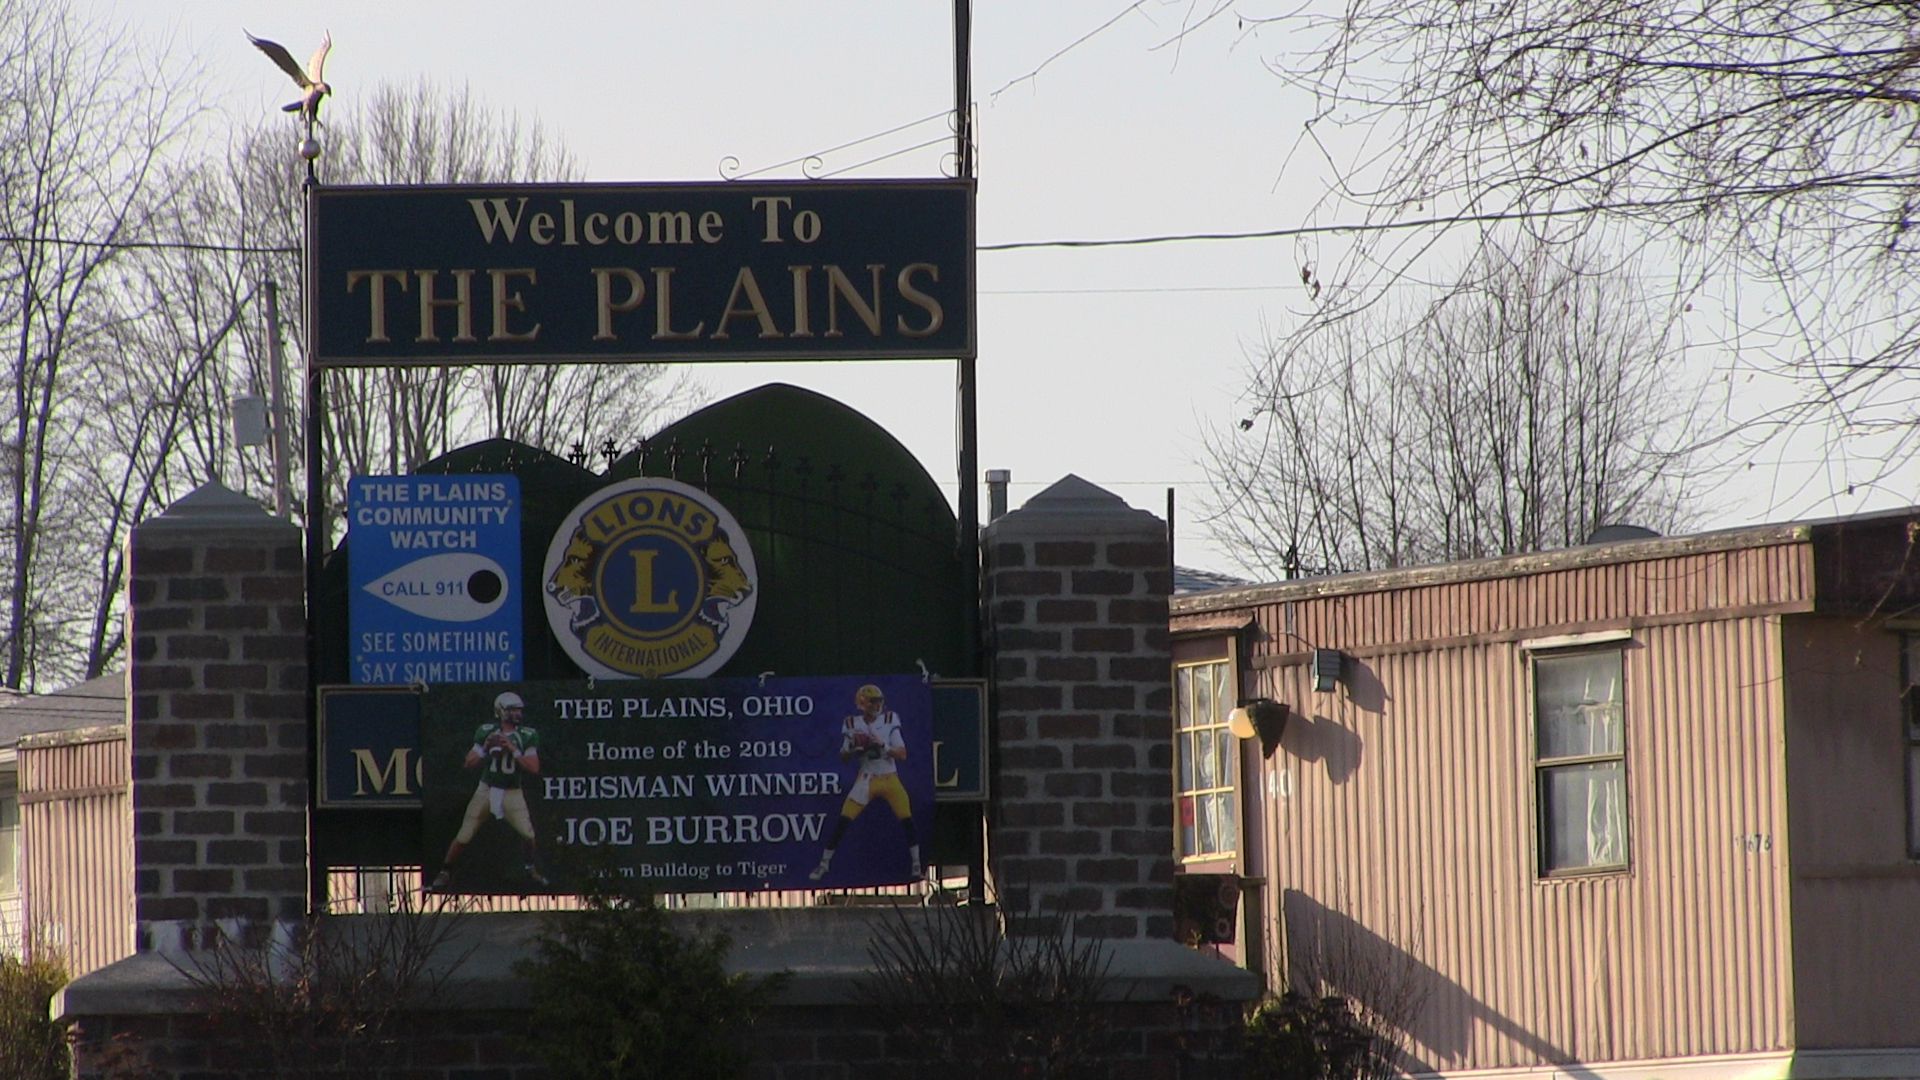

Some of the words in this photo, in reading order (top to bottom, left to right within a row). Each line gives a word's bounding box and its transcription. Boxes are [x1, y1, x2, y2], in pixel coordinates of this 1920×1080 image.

[469, 197, 724, 246] Welcome
[752, 196, 822, 244] To
[346, 268, 541, 343] THE
[591, 263, 943, 341] PLAINS
[360, 484, 409, 501] THE
[417, 483, 506, 501] PLAINS
[357, 507, 510, 526] COMMUNITY
[592, 496, 708, 536] LIONS
[390, 531, 477, 549] WATCH
[382, 582, 430, 596] CALL
[435, 581, 463, 595] 911
[629, 549, 679, 613] L
[362, 632, 396, 652] SEE
[402, 631, 510, 651] SOMETHING
[594, 633, 708, 667] INTERNATIONAL
[361, 663, 397, 682] SAY
[404, 661, 511, 682] SOMETHING
[554, 699, 613, 719] THE
[622, 697, 734, 719] PLAINS,
[742, 695, 814, 716] OHIO
[587, 742, 655, 760] Home
[662, 740, 686, 759] of
[694, 741, 731, 759] the
[739, 740, 792, 757] 2019
[543, 775, 694, 799] HEISMAN
[705, 772, 842, 796] WINNER
[556, 817, 633, 846] JOE
[646, 813, 827, 844] BURROW
[640, 863, 710, 880] Bulldog
[716, 863, 732, 875] to
[737, 861, 787, 879] Tiger
